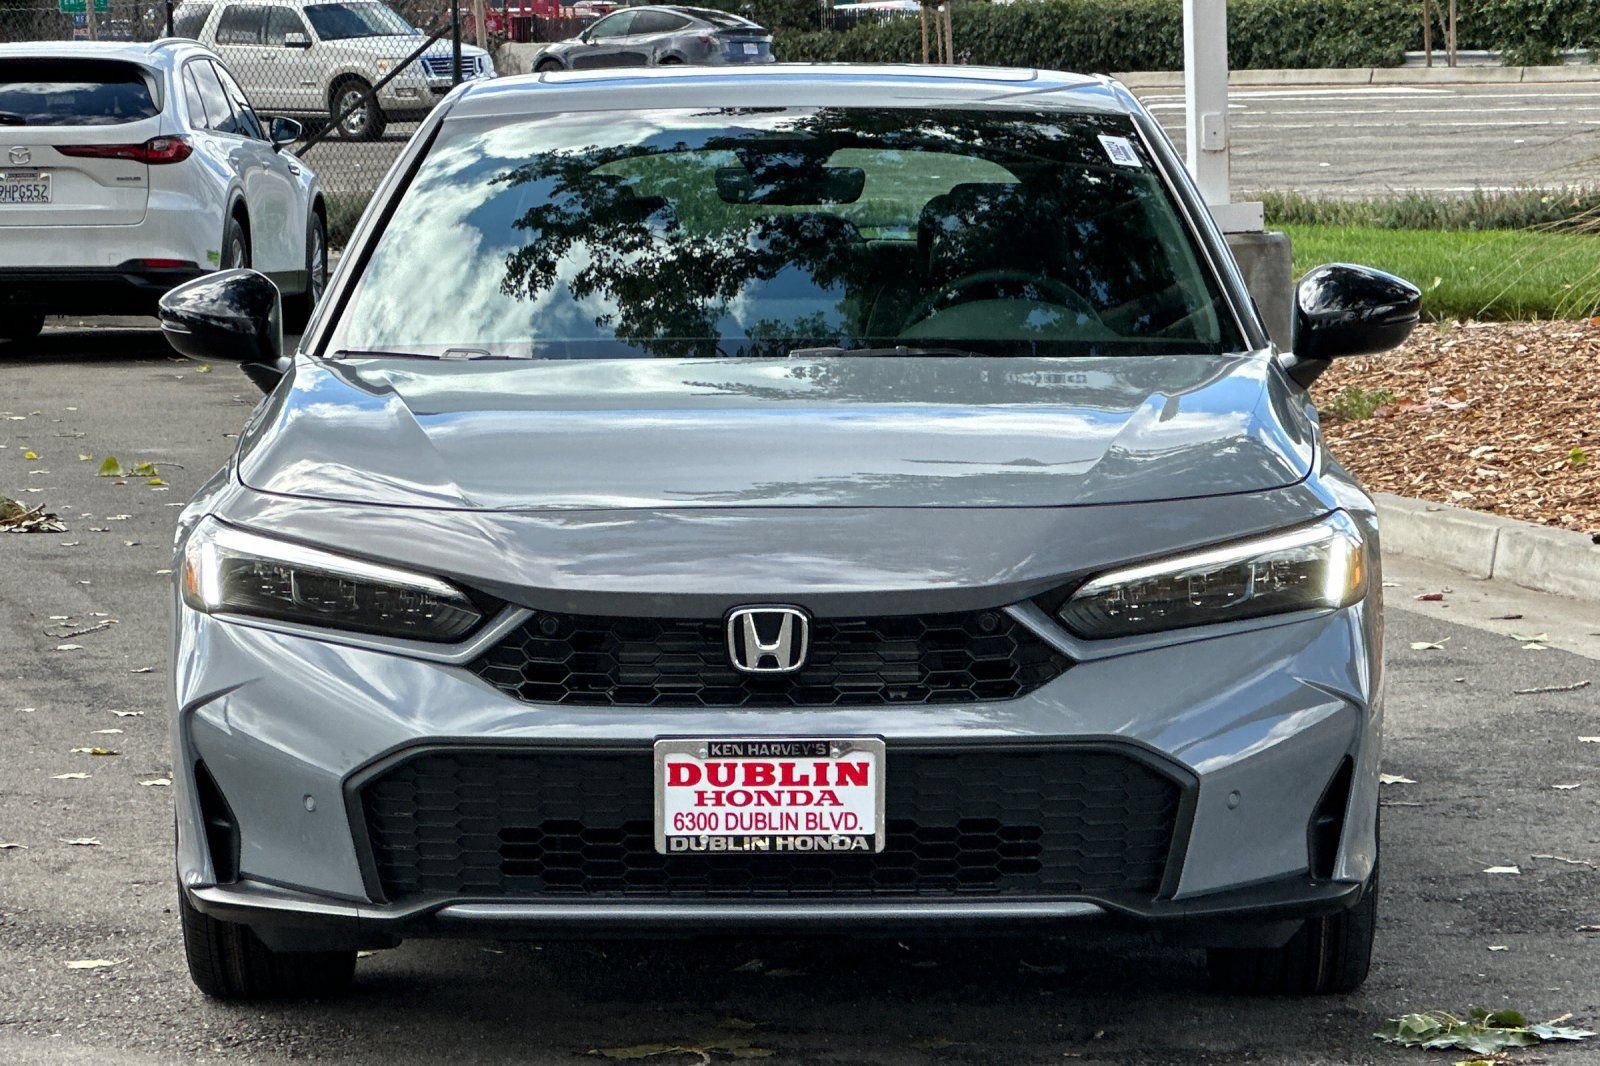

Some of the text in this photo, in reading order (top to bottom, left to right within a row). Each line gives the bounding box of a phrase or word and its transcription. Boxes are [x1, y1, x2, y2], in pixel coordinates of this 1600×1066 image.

[711, 743, 826, 756] KEN HARVEY'S
[667, 762, 870, 788] DUBLIN
[694, 790, 844, 807] HONDA
[673, 812, 863, 831] 6300 DUBLIN BLVD.
[670, 836, 870, 851] DUBLIN HONDA
